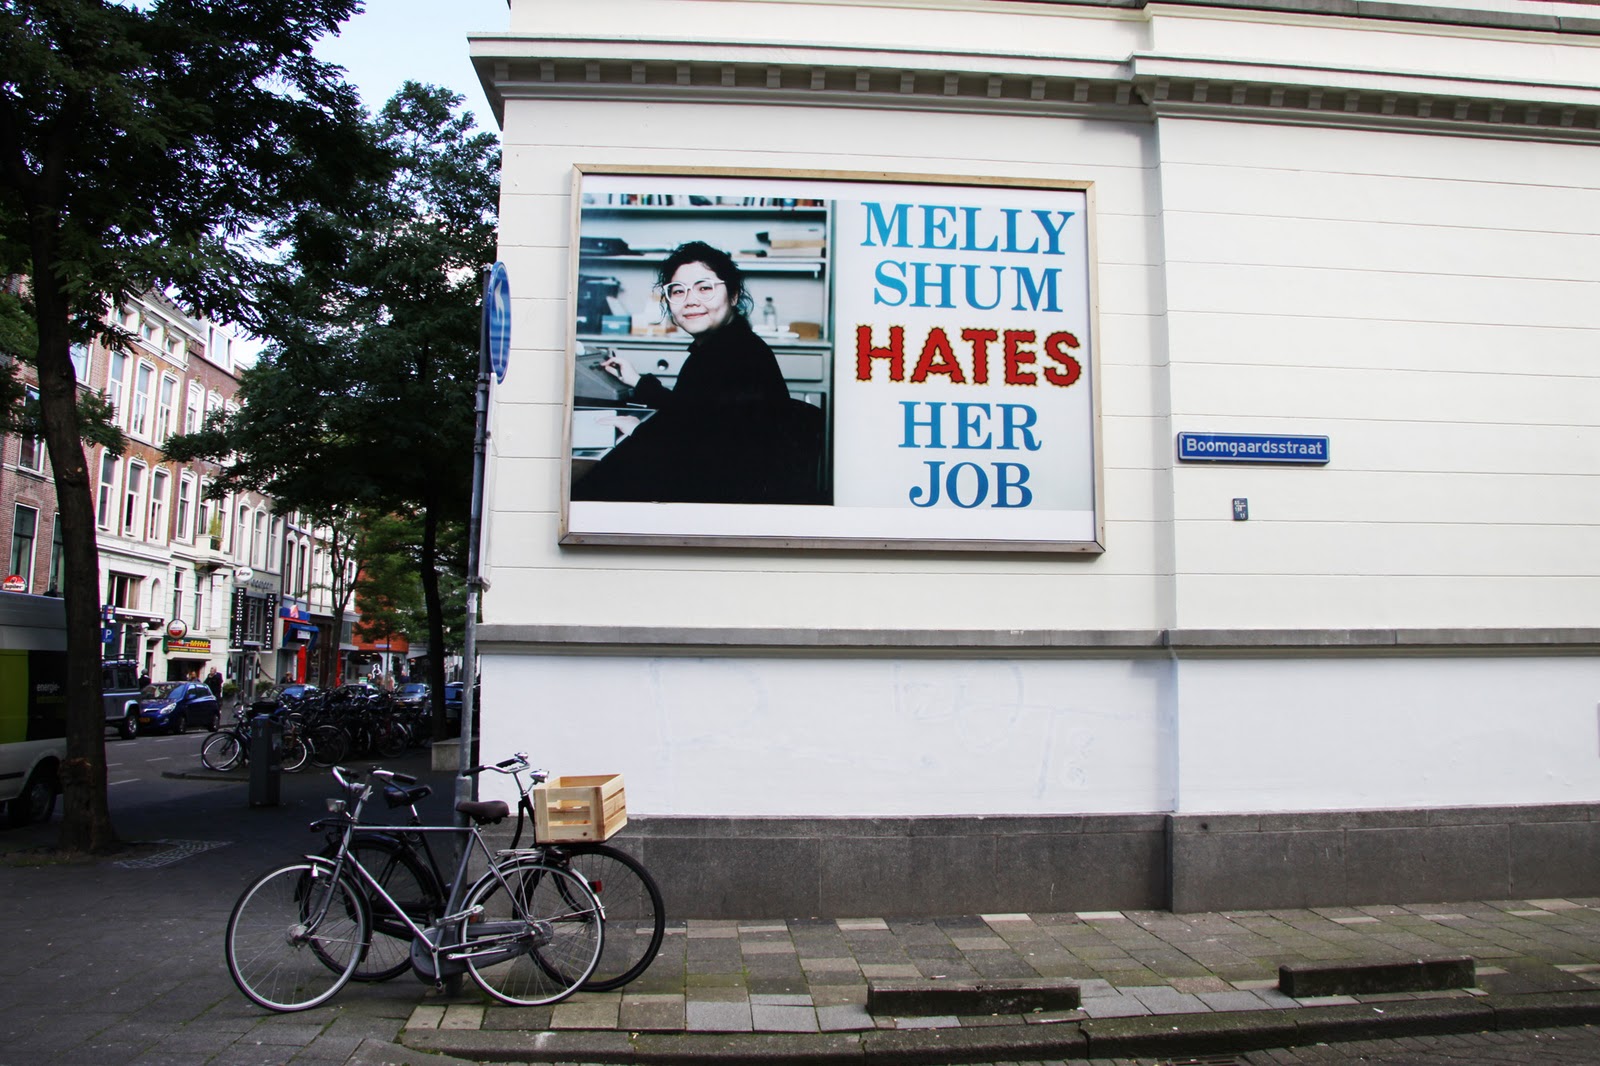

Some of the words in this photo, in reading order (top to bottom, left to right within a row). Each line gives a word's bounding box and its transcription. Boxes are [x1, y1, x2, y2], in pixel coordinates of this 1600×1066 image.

[860, 201, 1075, 255] MELLY
[874, 259, 1063, 313] SHUM
[855, 323, 1082, 389] HATES
[898, 400, 1042, 452] HER
[1186, 438, 1323, 456] Boomgaardsstraat
[908, 460, 1033, 509] JOB
[105, 629, 112, 638] P
